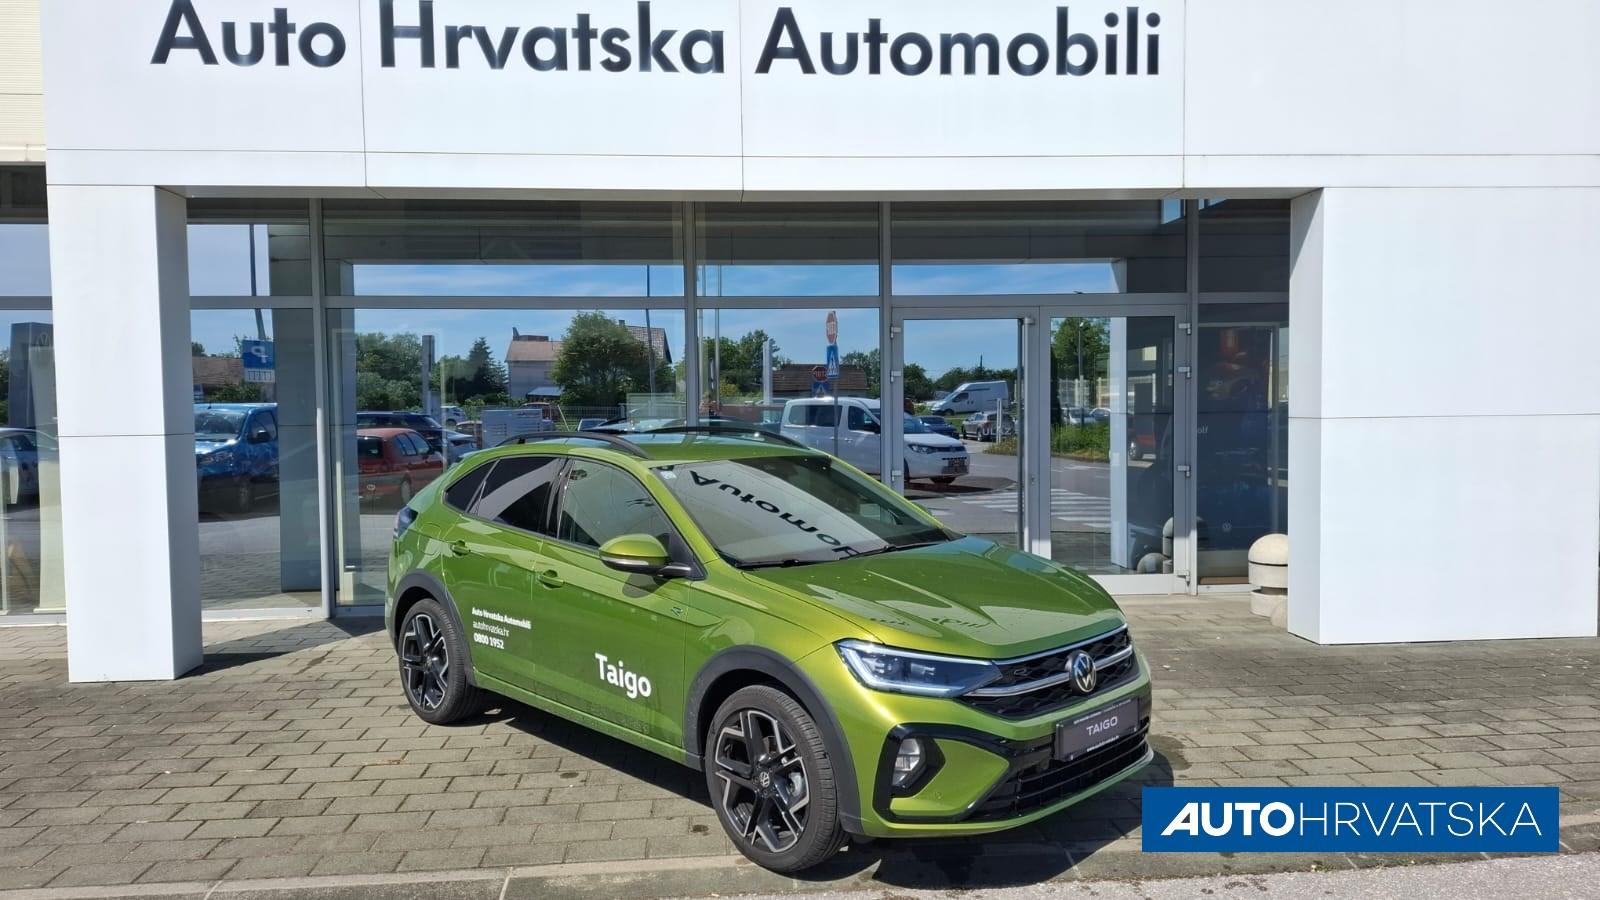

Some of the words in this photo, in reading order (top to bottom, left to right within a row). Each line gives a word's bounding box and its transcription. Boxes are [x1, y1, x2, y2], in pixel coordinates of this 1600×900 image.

[150, 0, 347, 68] Auto
[379, 0, 726, 75] Hrvatska
[754, 6, 1162, 76] Automobili
[472, 606, 483, 617] Auto
[483, 609, 504, 622] Hrvatska
[504, 614, 532, 630] Automobili
[473, 632, 489, 646] 0800
[489, 636, 505, 650] 1952
[595, 652, 652, 699] Taigo
[1086, 715, 1119, 737] TAIGO
